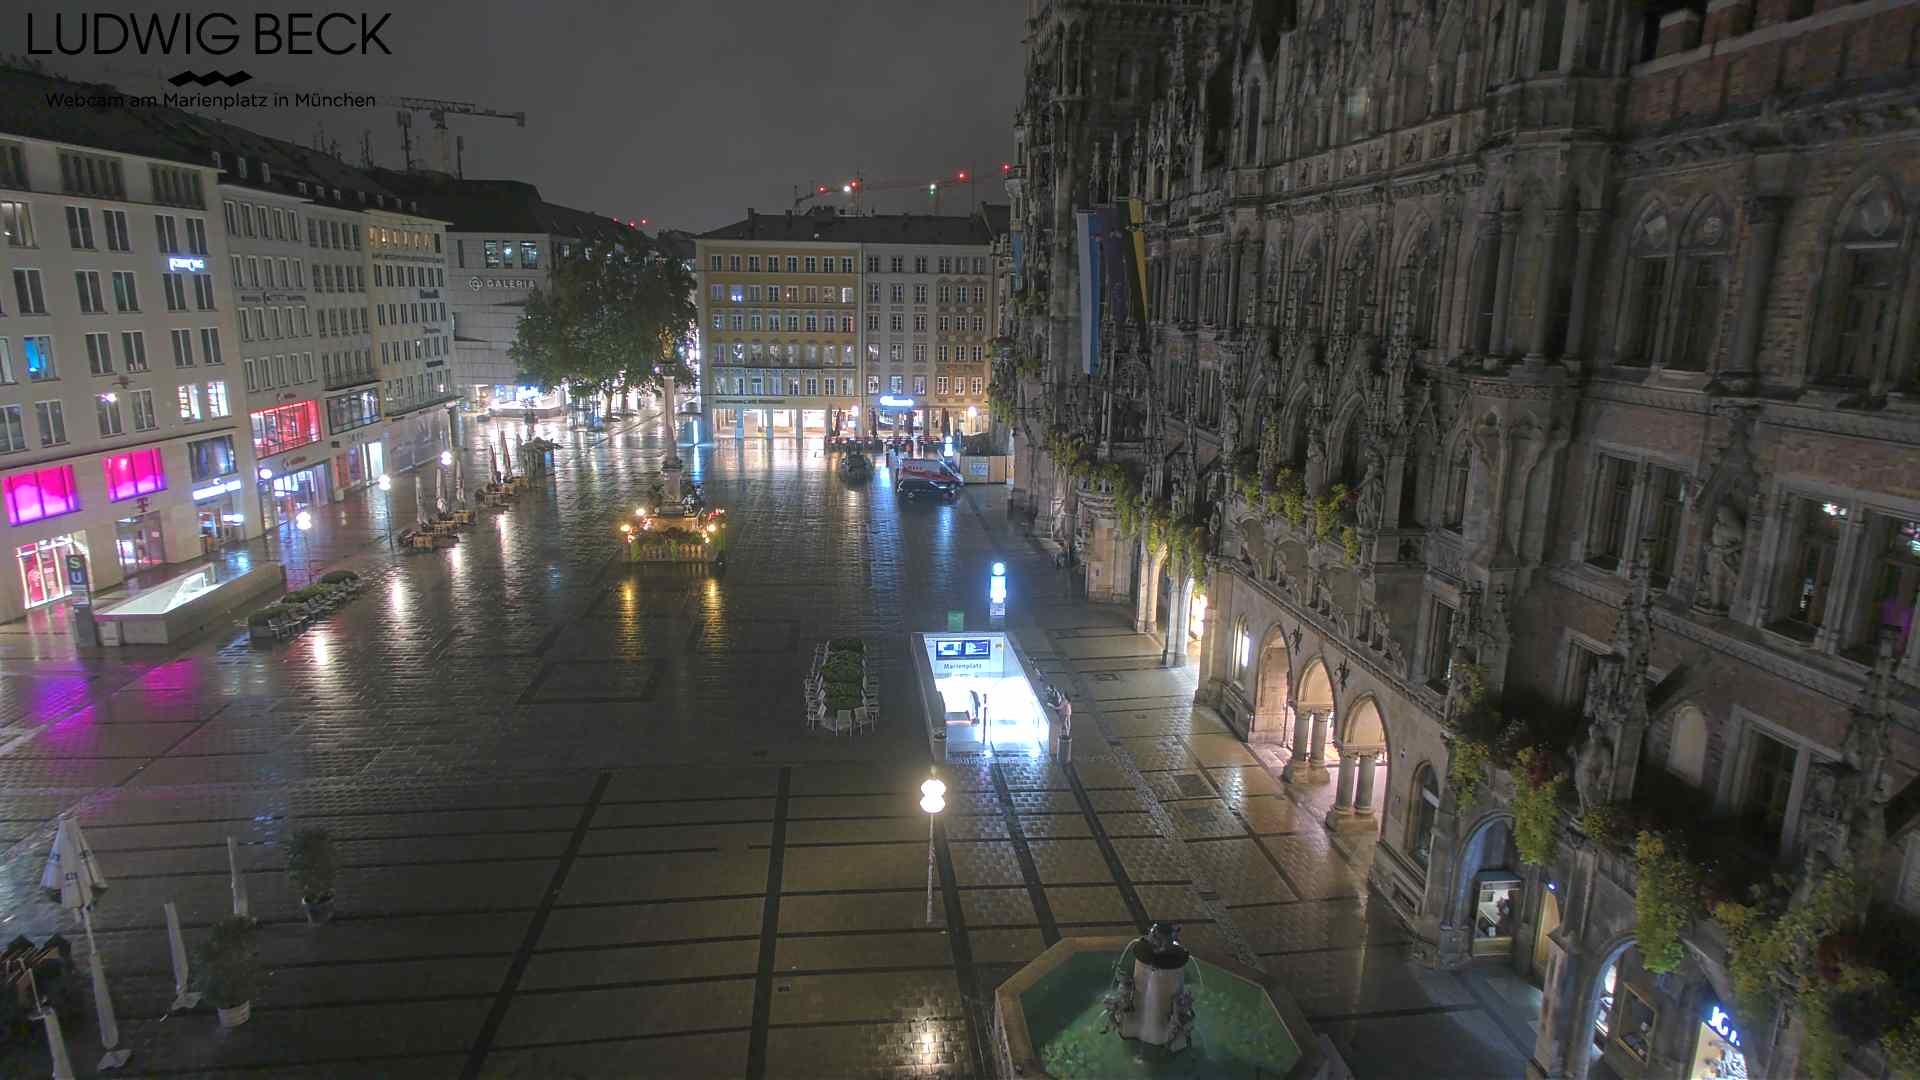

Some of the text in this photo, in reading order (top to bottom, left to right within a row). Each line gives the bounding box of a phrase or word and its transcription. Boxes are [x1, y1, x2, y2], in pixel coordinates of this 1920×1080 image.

[487, 279, 537, 289] GALERIA
[69, 558, 80, 568] S
[72, 572, 82, 583] U
